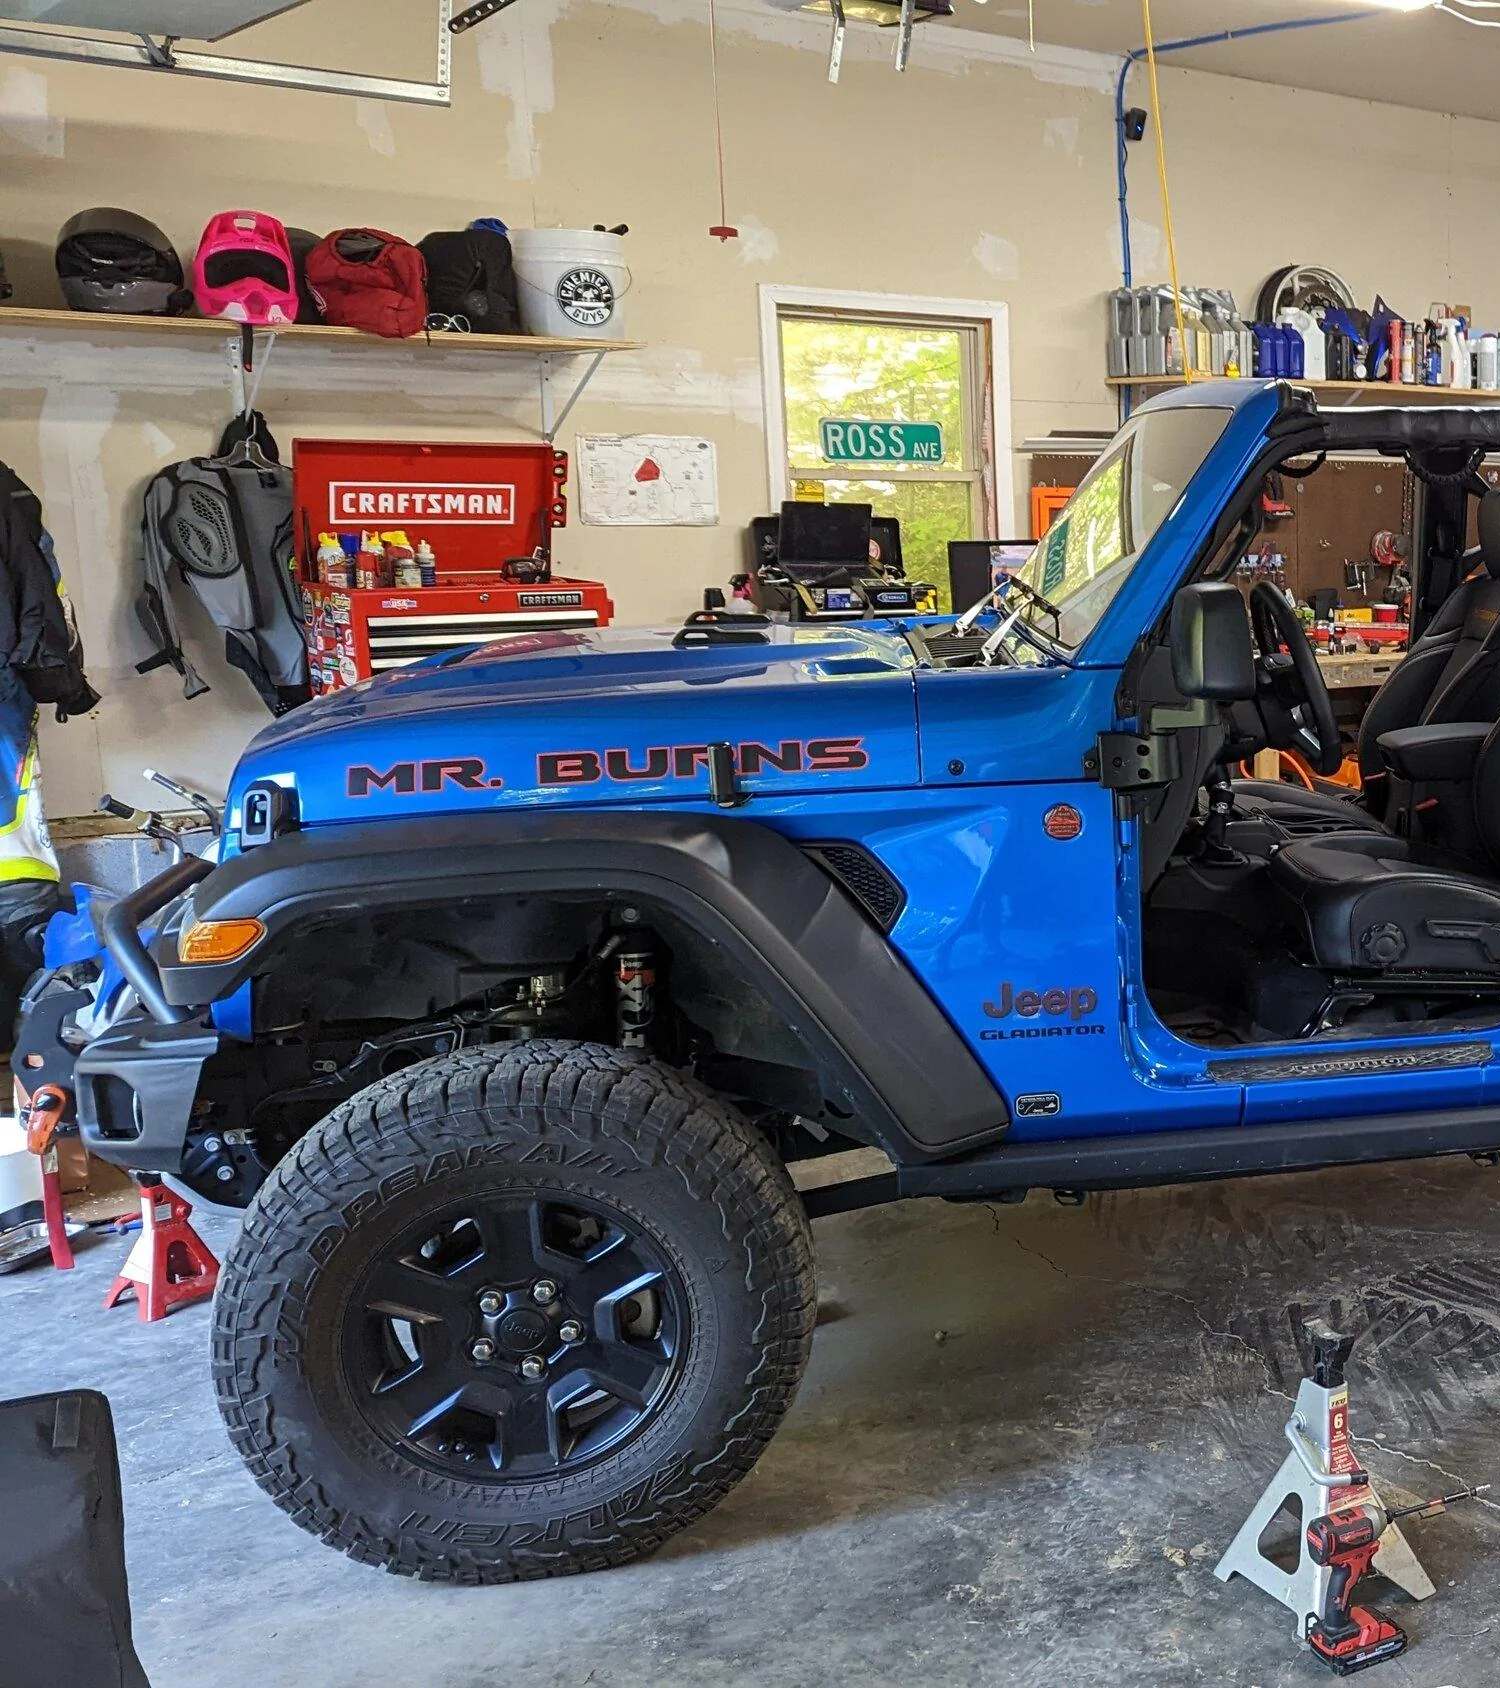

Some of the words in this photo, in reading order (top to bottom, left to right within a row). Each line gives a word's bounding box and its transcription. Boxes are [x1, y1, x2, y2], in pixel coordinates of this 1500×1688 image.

[561, 272, 612, 300] CHEMICAL
[573, 308, 605, 322] GUYS
[826, 424, 905, 458] ROSS
[913, 443, 940, 459] AVE
[342, 492, 502, 515] CRAFTSMAN
[522, 595, 579, 605] CRAFTSMAN
[347, 758, 503, 797] MR.
[536, 736, 868, 785] BURNS
[983, 981, 1098, 1021] Jeep
[980, 1024, 1106, 1040] GLADIATOR
[272, 1141, 516, 1367] WILDPEAK
[1333, 1413, 1344, 1429] 6
